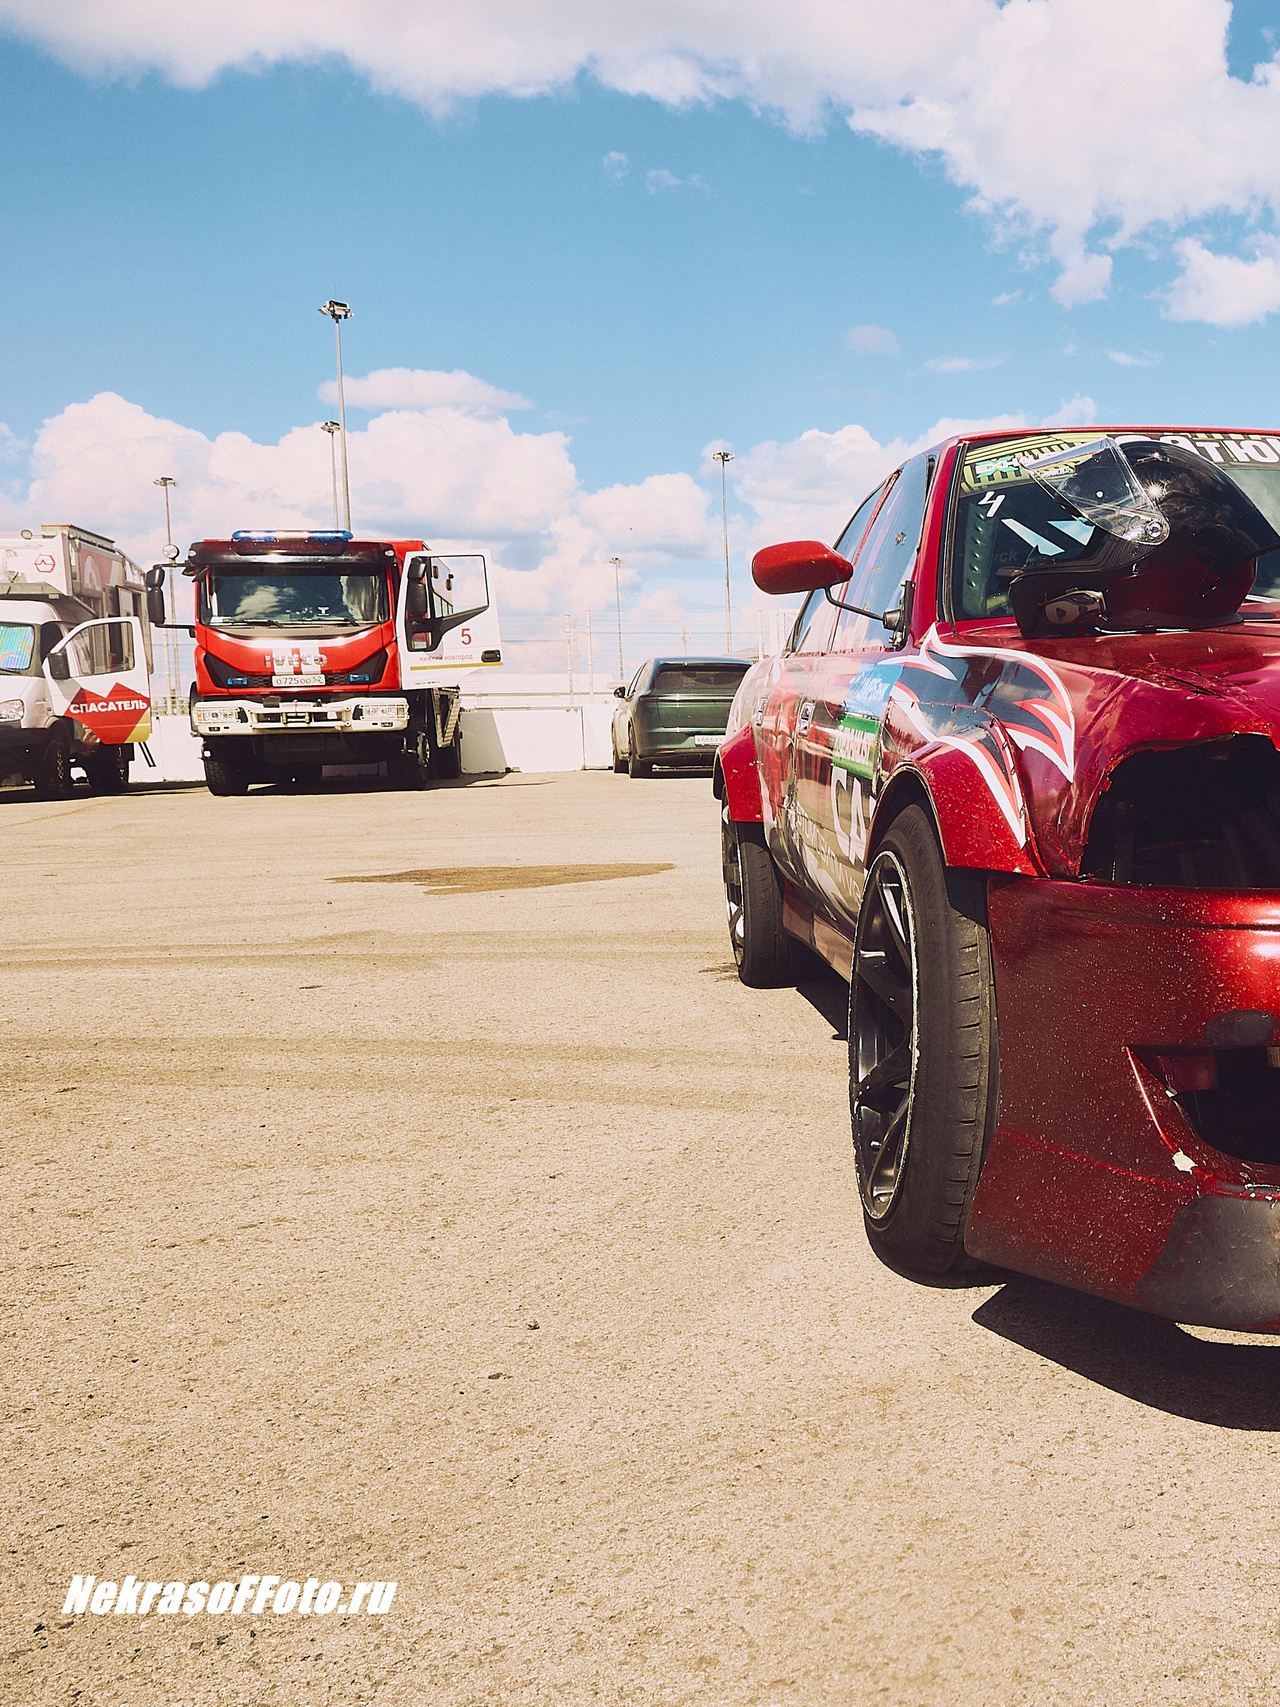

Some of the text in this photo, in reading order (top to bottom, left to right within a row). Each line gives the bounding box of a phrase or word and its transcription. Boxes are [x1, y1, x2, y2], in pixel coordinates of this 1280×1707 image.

[461, 628, 472, 645] 5
[264, 653, 328, 668] IVECO
[69, 700, 147, 714] СПАСАТЕЛЬ
